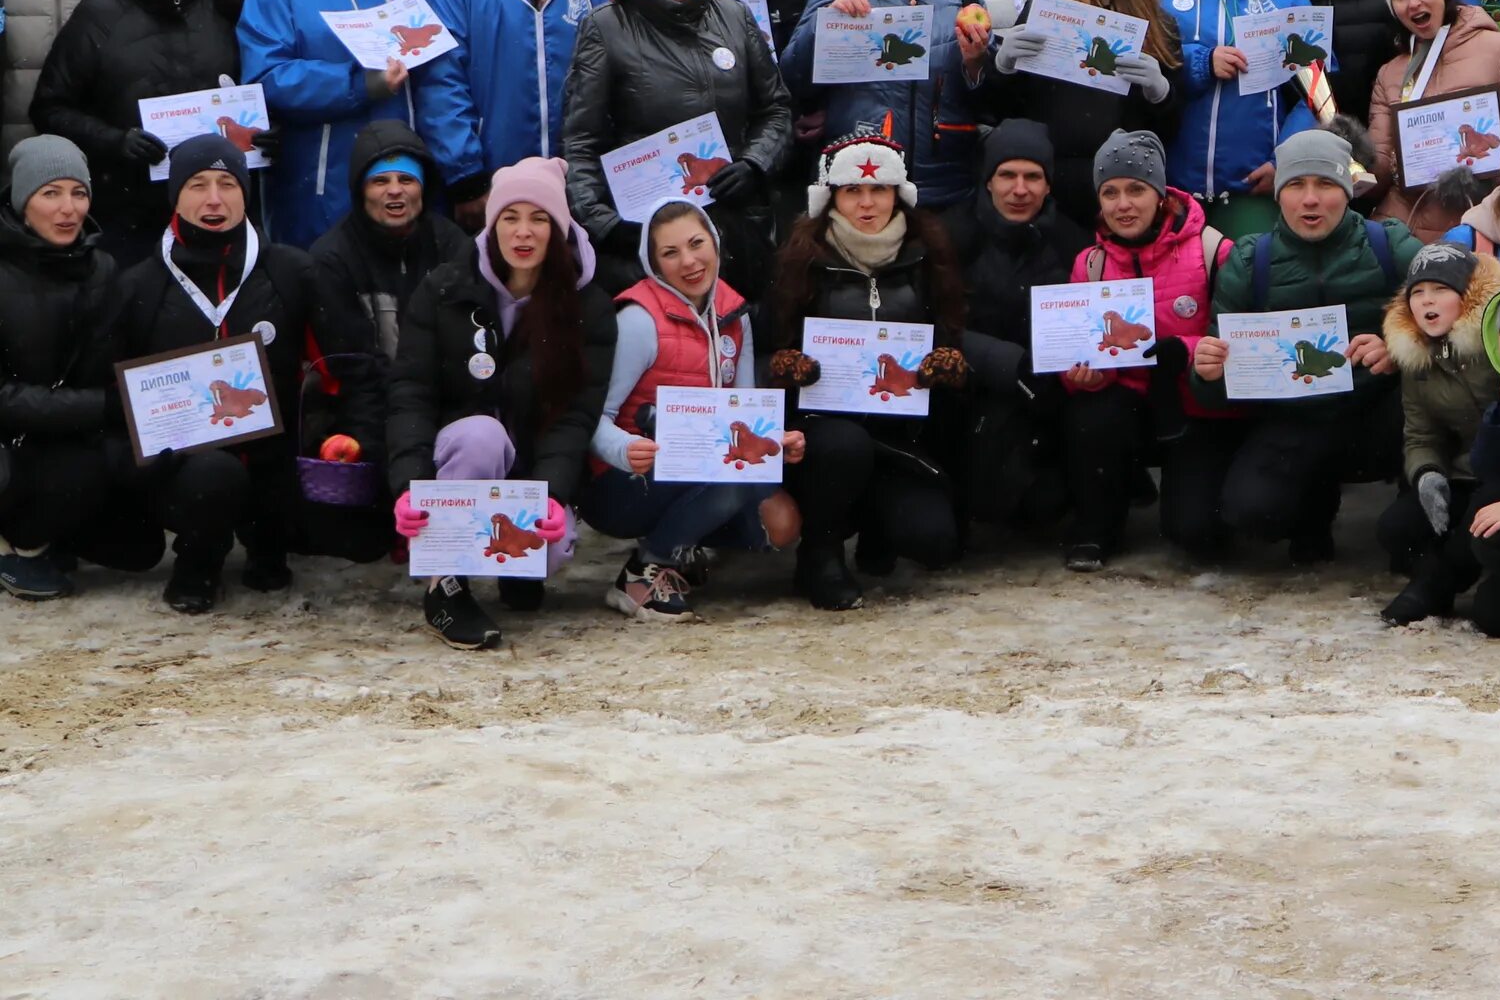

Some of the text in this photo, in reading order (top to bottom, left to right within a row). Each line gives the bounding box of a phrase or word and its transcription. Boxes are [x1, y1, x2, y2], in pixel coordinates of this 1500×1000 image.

[1039, 8, 1086, 27] СЕРТИФИКАТ
[826, 22, 873, 31] СЕРТИФИКАТ
[1243, 25, 1281, 39] СЕРТИФИКАТ
[150, 106, 203, 122] СЕРТИФИКАТ
[1406, 111, 1446, 128] ДИПЛОМ
[613, 148, 662, 174] СЕРТИФИКАТ
[1040, 299, 1090, 310] СЕРТИФИКАТ
[1230, 329, 1281, 340] СЕРТИФИКАТ
[812, 335, 866, 346] СЕРТИФИКАТ
[139, 371, 191, 393] ДИПЛОМ
[167, 399, 192, 410] МЕСТО
[666, 404, 717, 415] СЕРТИФИКАТ
[420, 498, 478, 508] СЕРТИФИКАТ
